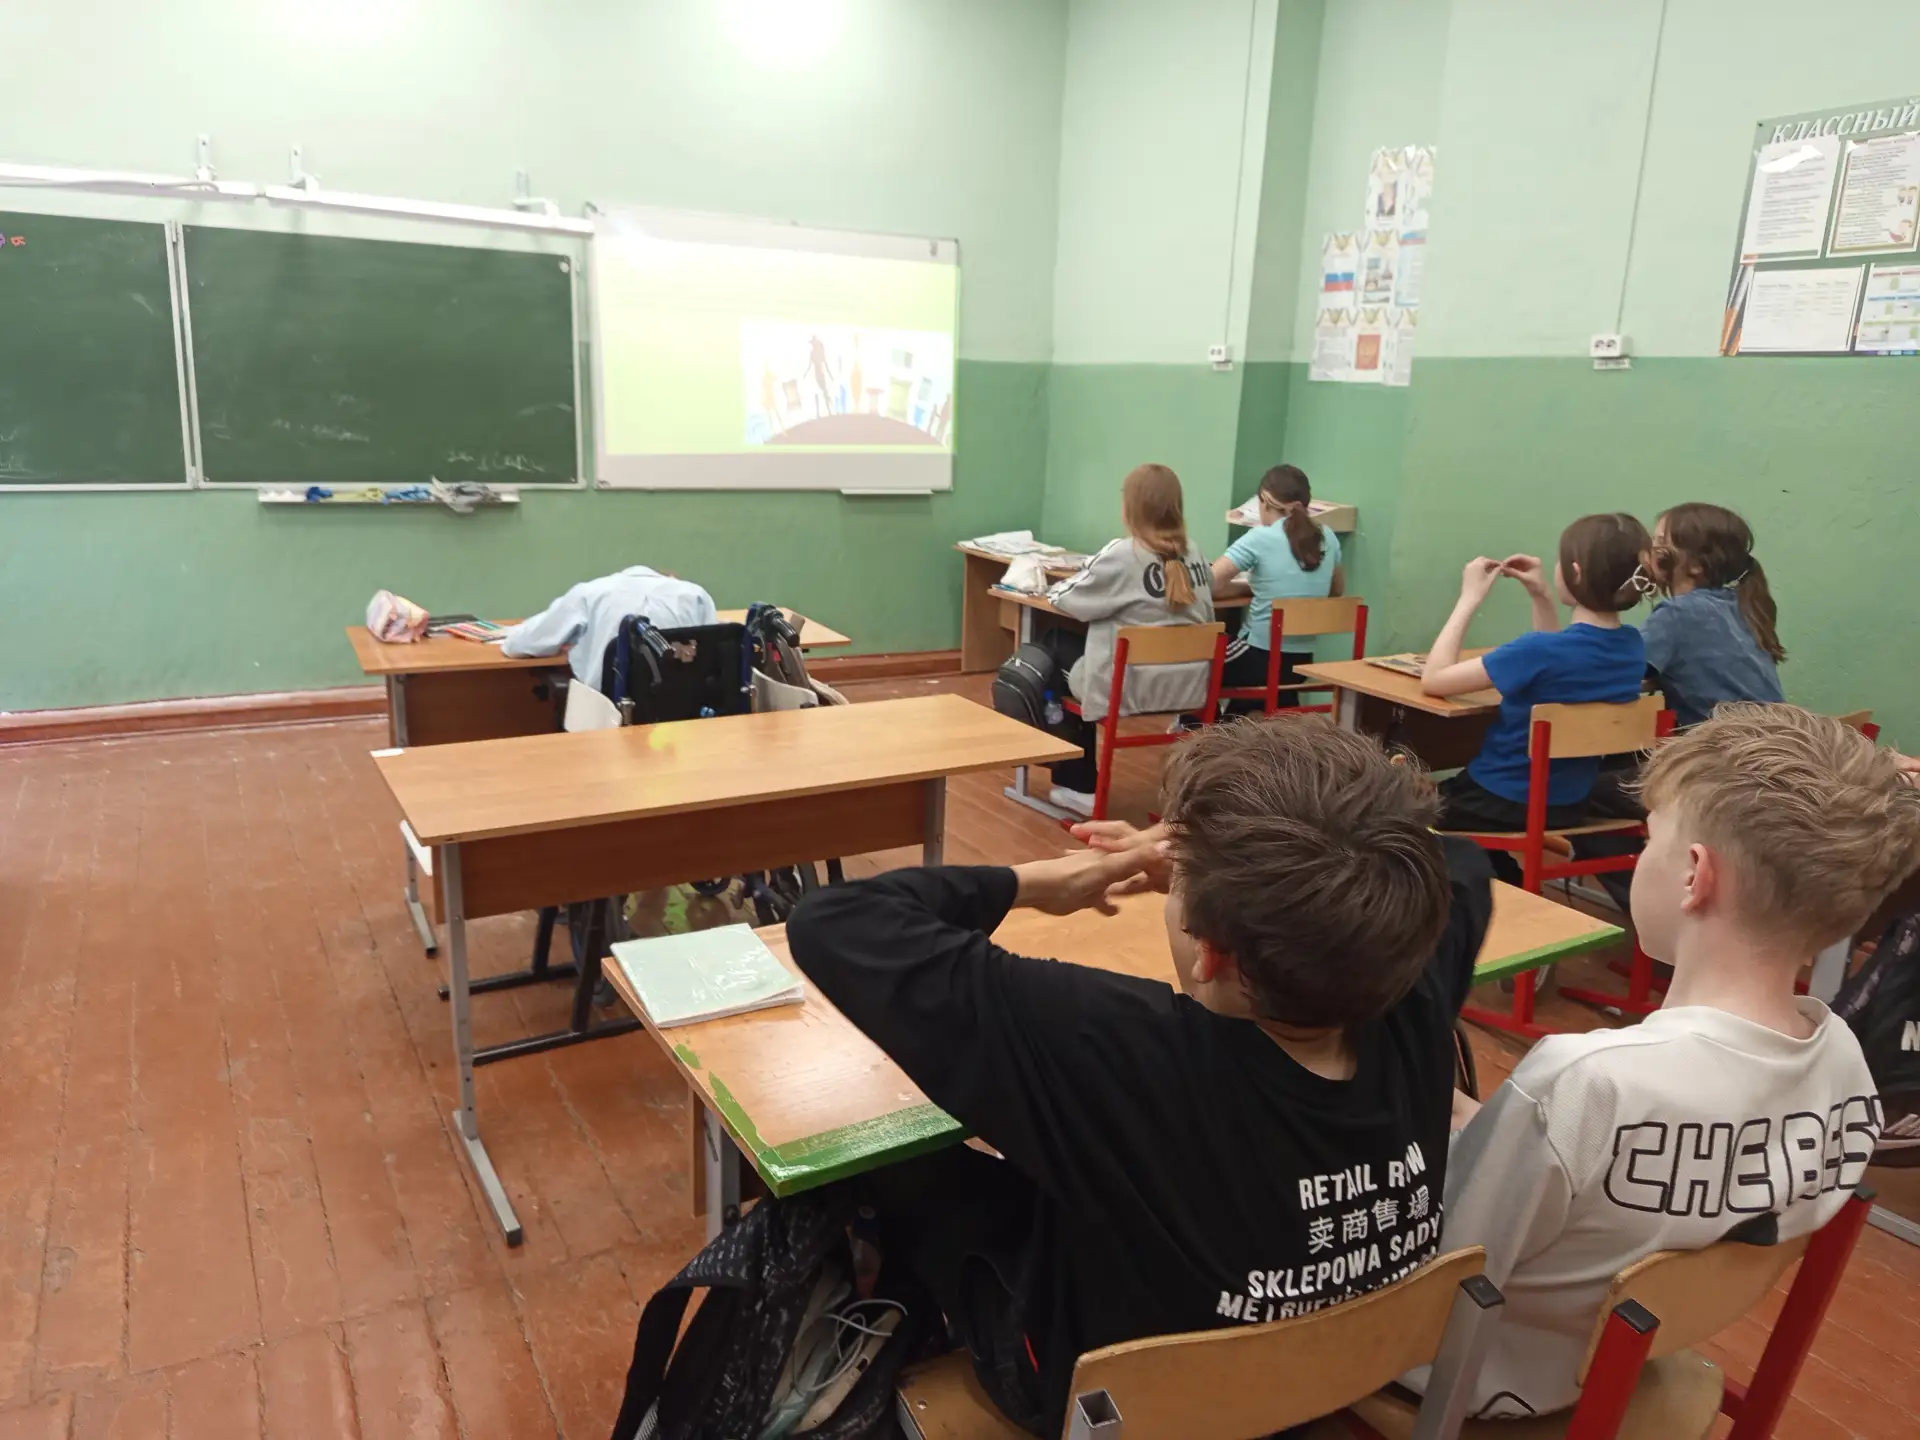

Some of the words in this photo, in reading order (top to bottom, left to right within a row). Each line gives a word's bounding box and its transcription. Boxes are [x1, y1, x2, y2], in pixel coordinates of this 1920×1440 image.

[1769, 98, 1920, 144] КЛАССНЫЙ
[1299, 1164, 1378, 1210] RETAIL
[1247, 1243, 1382, 1299] SKLEPOWA
[1389, 1201, 1443, 1262] SADY
